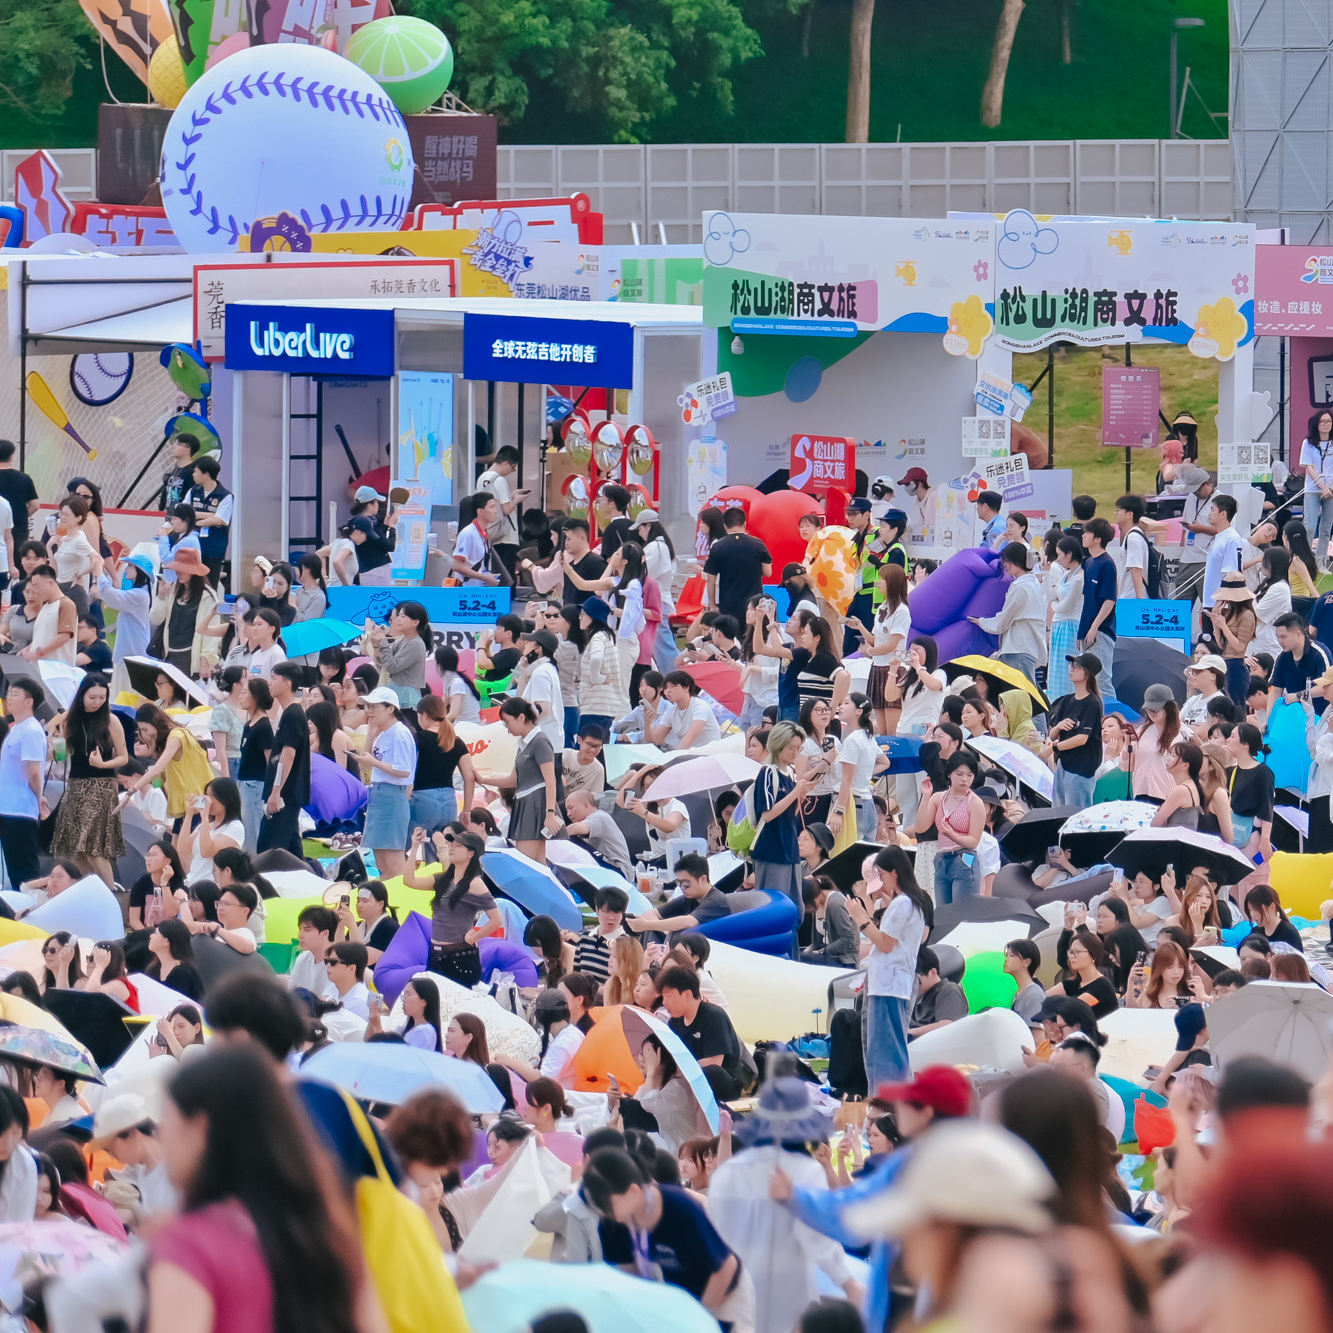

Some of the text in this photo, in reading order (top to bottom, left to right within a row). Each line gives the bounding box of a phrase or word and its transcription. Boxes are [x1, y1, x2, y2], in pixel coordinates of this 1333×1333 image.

[424, 135, 478, 158] 醒神好喝
[423, 160, 475, 187] 当然战马
[369, 278, 442, 295] 承拓莞香文化
[514, 282, 592, 302] 东莞松山湖优品
[203, 280, 225, 330] 莞香
[730, 279, 858, 319] 松山湖商文旅
[999, 285, 1179, 328] 松山湖商文旅
[1257, 300, 1323, 315] 妆造、应援妆
[250, 321, 354, 359] LiberLive
[1001, 339, 1044, 350] SONGSHANLAKE
[491, 338, 598, 364] 全球无弦吉他开创者
[696, 376, 728, 397] 乐迷礼包
[705, 390, 730, 408] 免费领
[813, 441, 845, 460] 松山湖
[812, 461, 845, 480] 商文旅
[985, 457, 1024, 478] 乐迷礼包
[997, 472, 1026, 489] 免费领
[1003, 484, 1034, 501] 100%中奖
[458, 600, 496, 611] 5.2-4
[1141, 614, 1179, 625] 5.2-4
